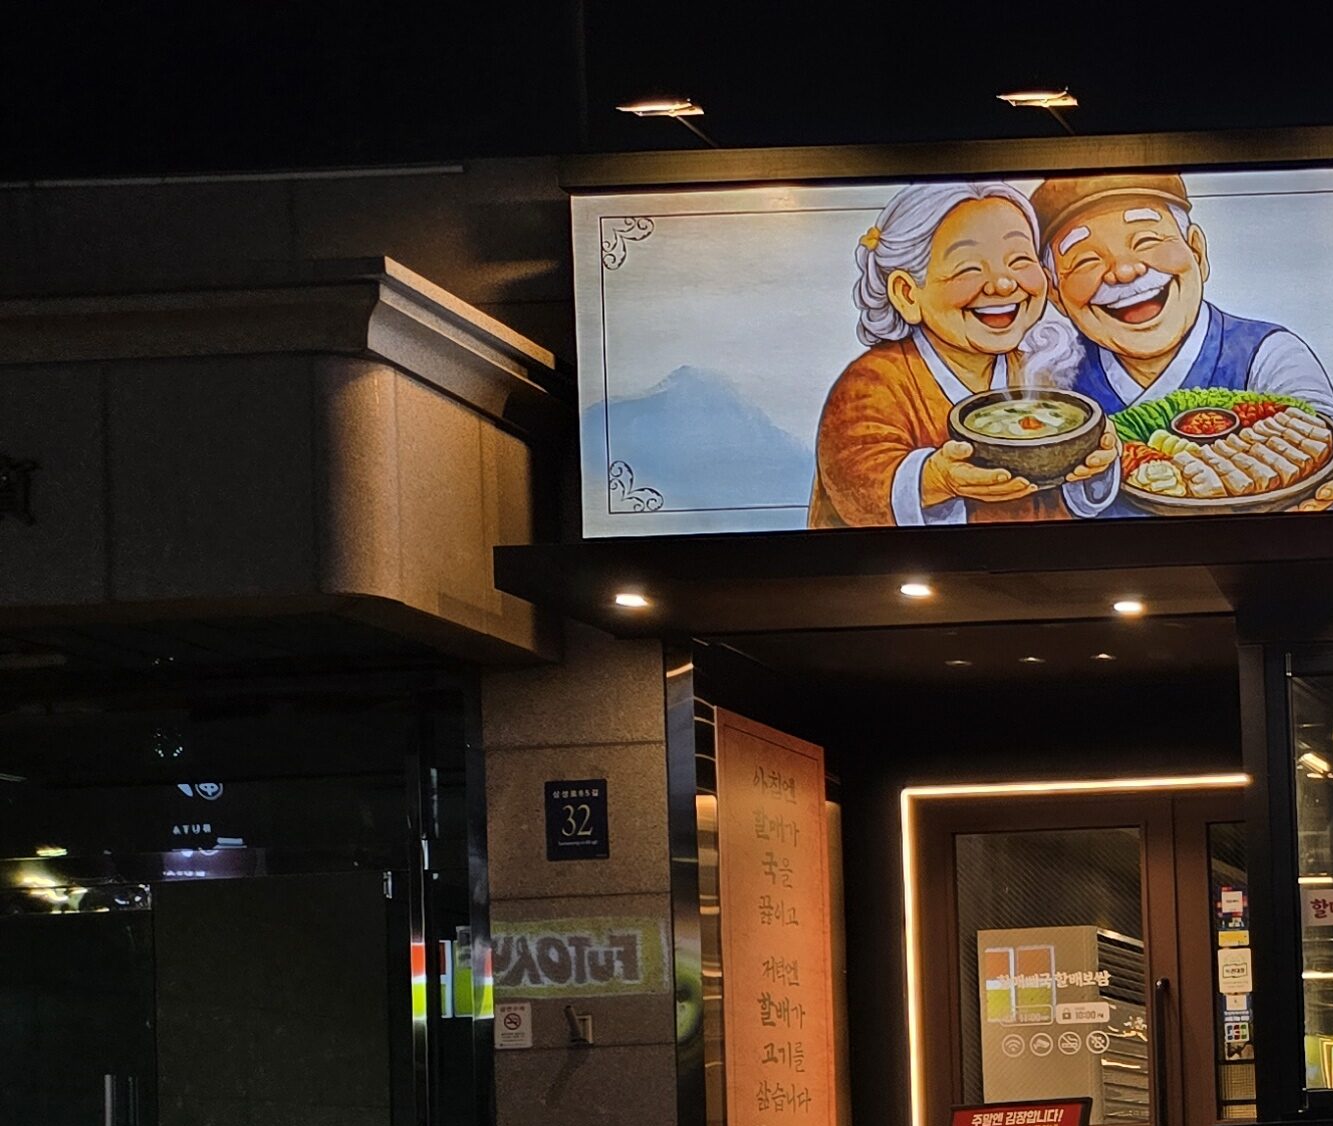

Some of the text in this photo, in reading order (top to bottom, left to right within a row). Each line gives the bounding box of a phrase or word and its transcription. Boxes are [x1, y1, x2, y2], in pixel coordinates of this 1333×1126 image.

[753, 766, 798, 804] 아침엔
[561, 804, 593, 836] 32
[752, 807, 800, 847] 할매가
[761, 852, 793, 888] 국을
[1054, 970, 1111, 988] 할배보쌈
[757, 992, 806, 1029] 할배가
[761, 1042, 806, 1072] 고기를
[756, 1080, 812, 1113] 삶습니다
[971, 1109, 1064, 1126] 주말엔 김장입니다!
